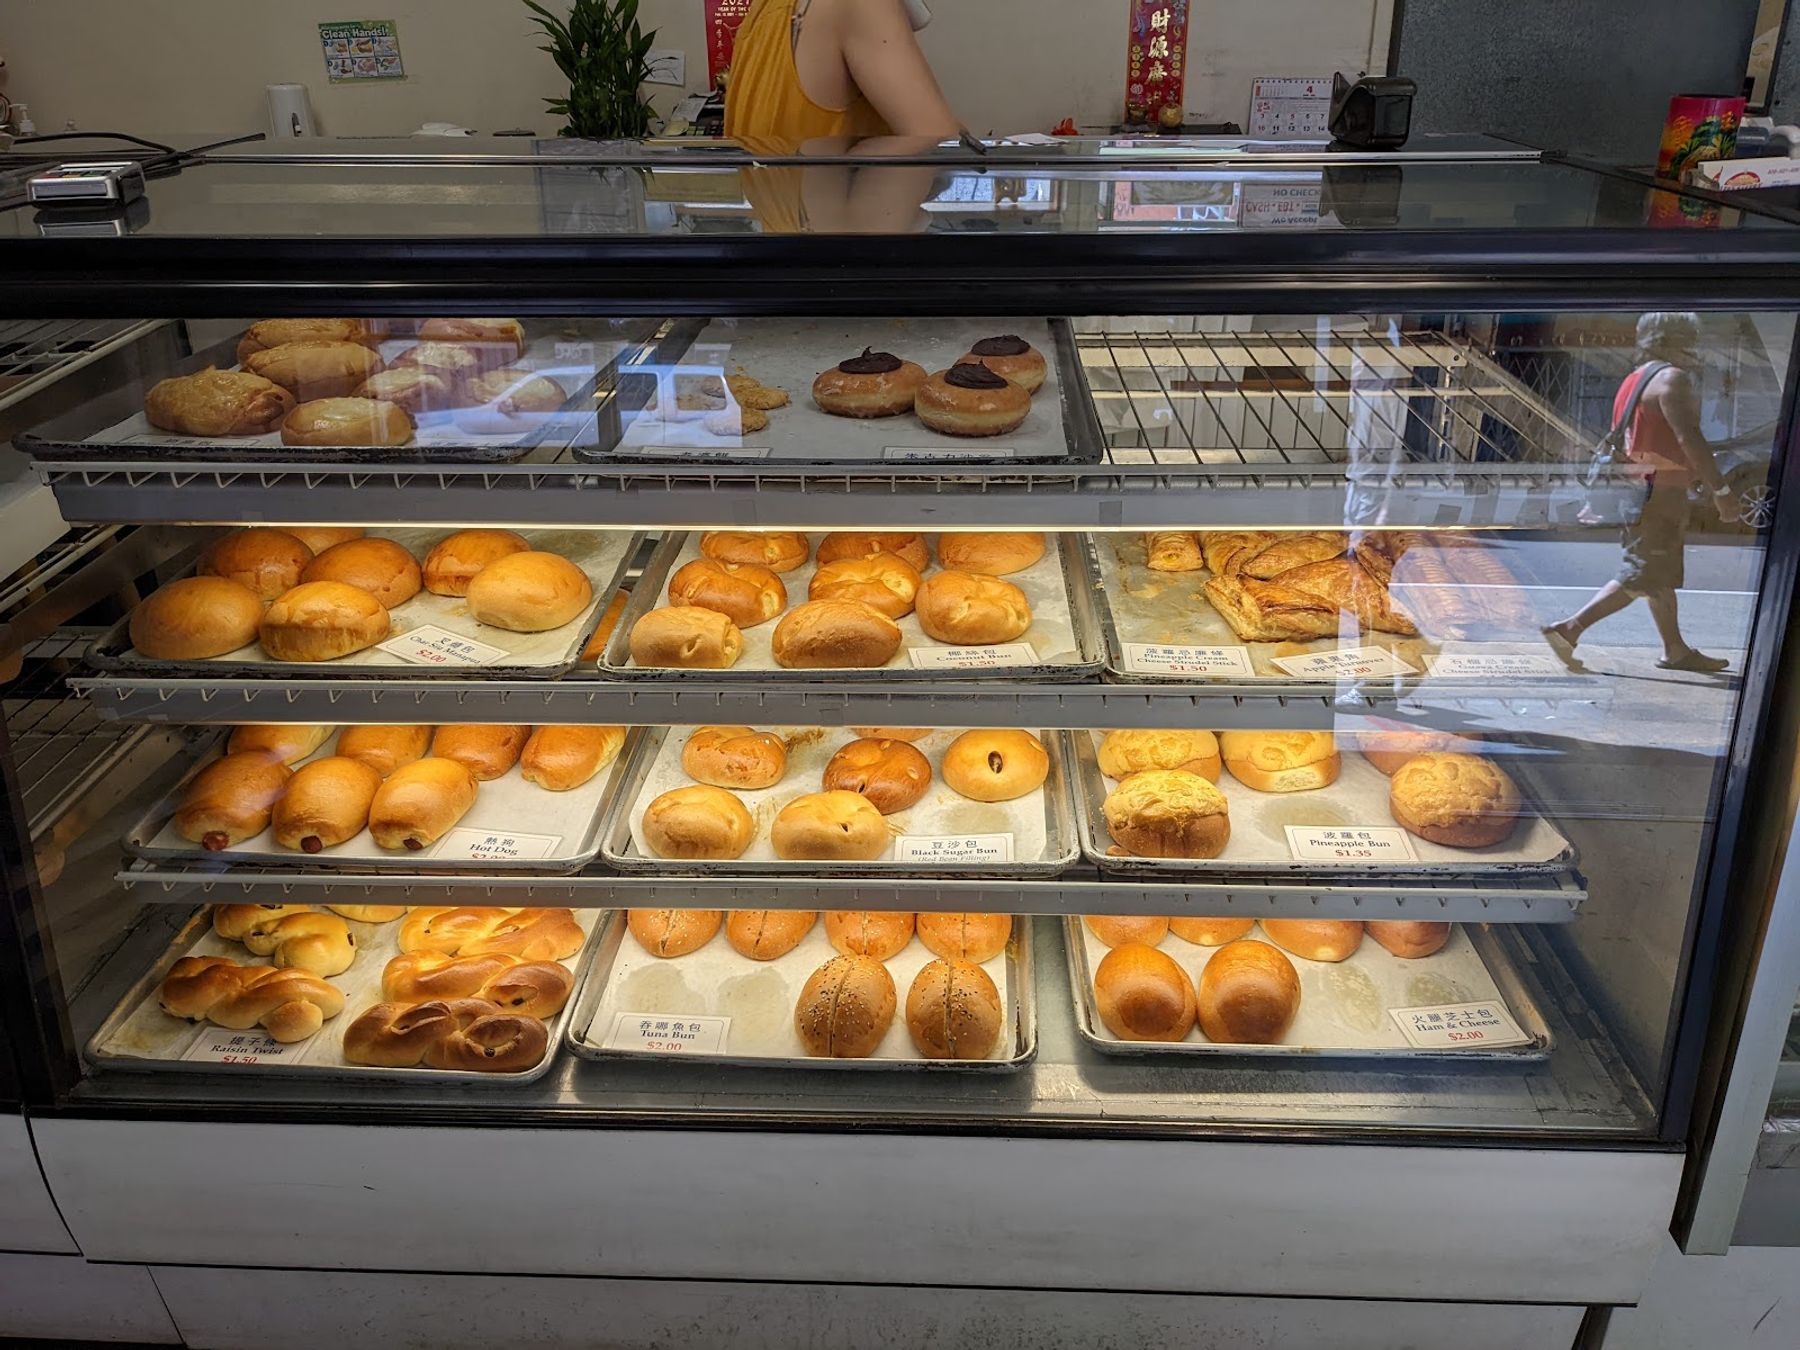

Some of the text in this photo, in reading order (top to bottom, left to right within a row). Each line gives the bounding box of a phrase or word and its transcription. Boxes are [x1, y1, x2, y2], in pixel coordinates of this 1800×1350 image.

[321, 29, 350, 38] Clean
[352, 26, 386, 37] Hands!
[1145, 8, 1171, 104] 財源廣
[416, 649, 446, 663] $2.00
[1144, 653, 1193, 661] Pineapple
[1168, 664, 1208, 672] $1.50
[1303, 657, 1385, 673] Apple Turnover
[1309, 839, 1392, 848] Pineapple Bun
[469, 843, 519, 856] Hot Dog
[942, 849, 973, 857] Sugar
[1335, 849, 1372, 857] $1.35
[1414, 1023, 1445, 1032] Ham
[1458, 1018, 1501, 1029] Cheese
[640, 1029, 696, 1040] Tuna Bun
[1447, 1030, 1484, 1041] $2.00
[210, 1045, 285, 1055] Raisin Twist
[646, 1041, 683, 1051] $2.00
[222, 1055, 258, 1064] $1.50
